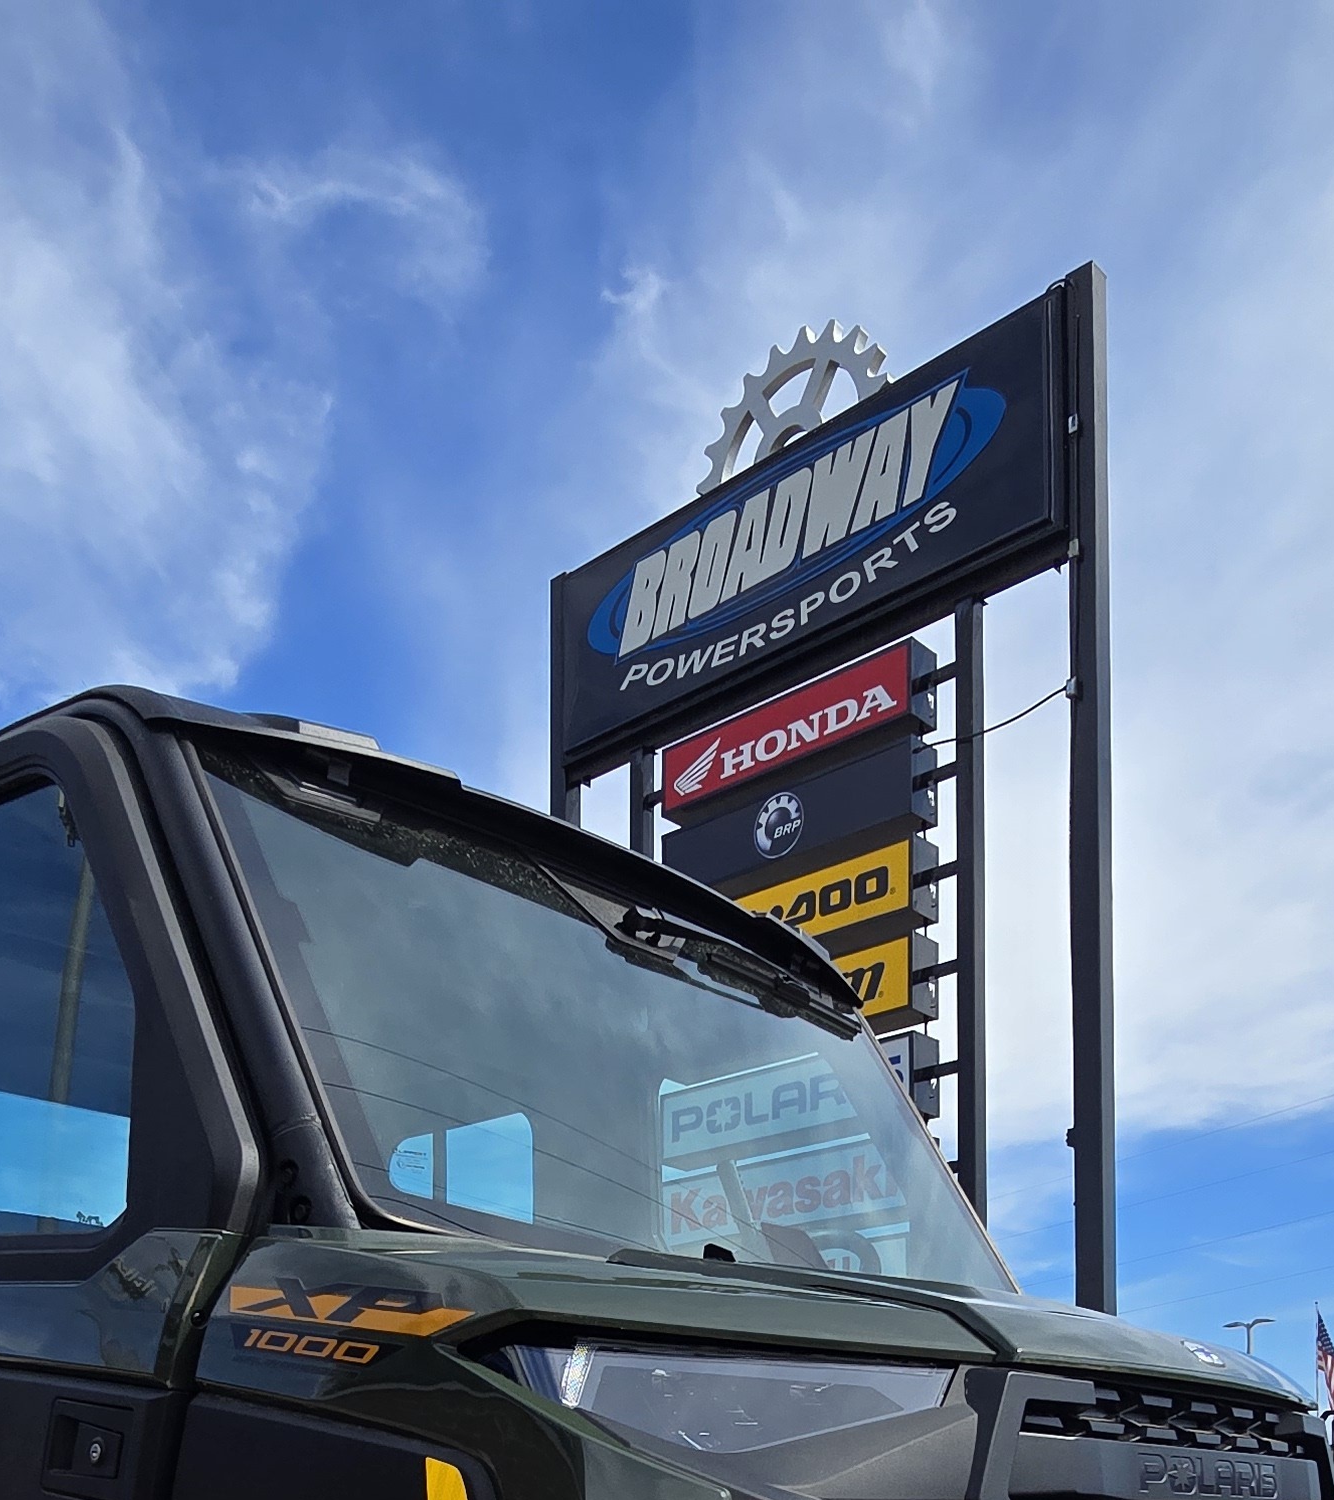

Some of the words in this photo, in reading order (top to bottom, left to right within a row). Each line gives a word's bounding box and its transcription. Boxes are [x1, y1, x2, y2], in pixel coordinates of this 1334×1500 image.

[619, 379, 960, 657] BROADWAY
[620, 501, 957, 690] POWERSPORTS
[720, 684, 897, 780] HONDA
[774, 818, 801, 839] BRP
[236, 1276, 446, 1324] XP
[243, 1328, 380, 1365] 1000
[1137, 1452, 1280, 1500] POLARIS
